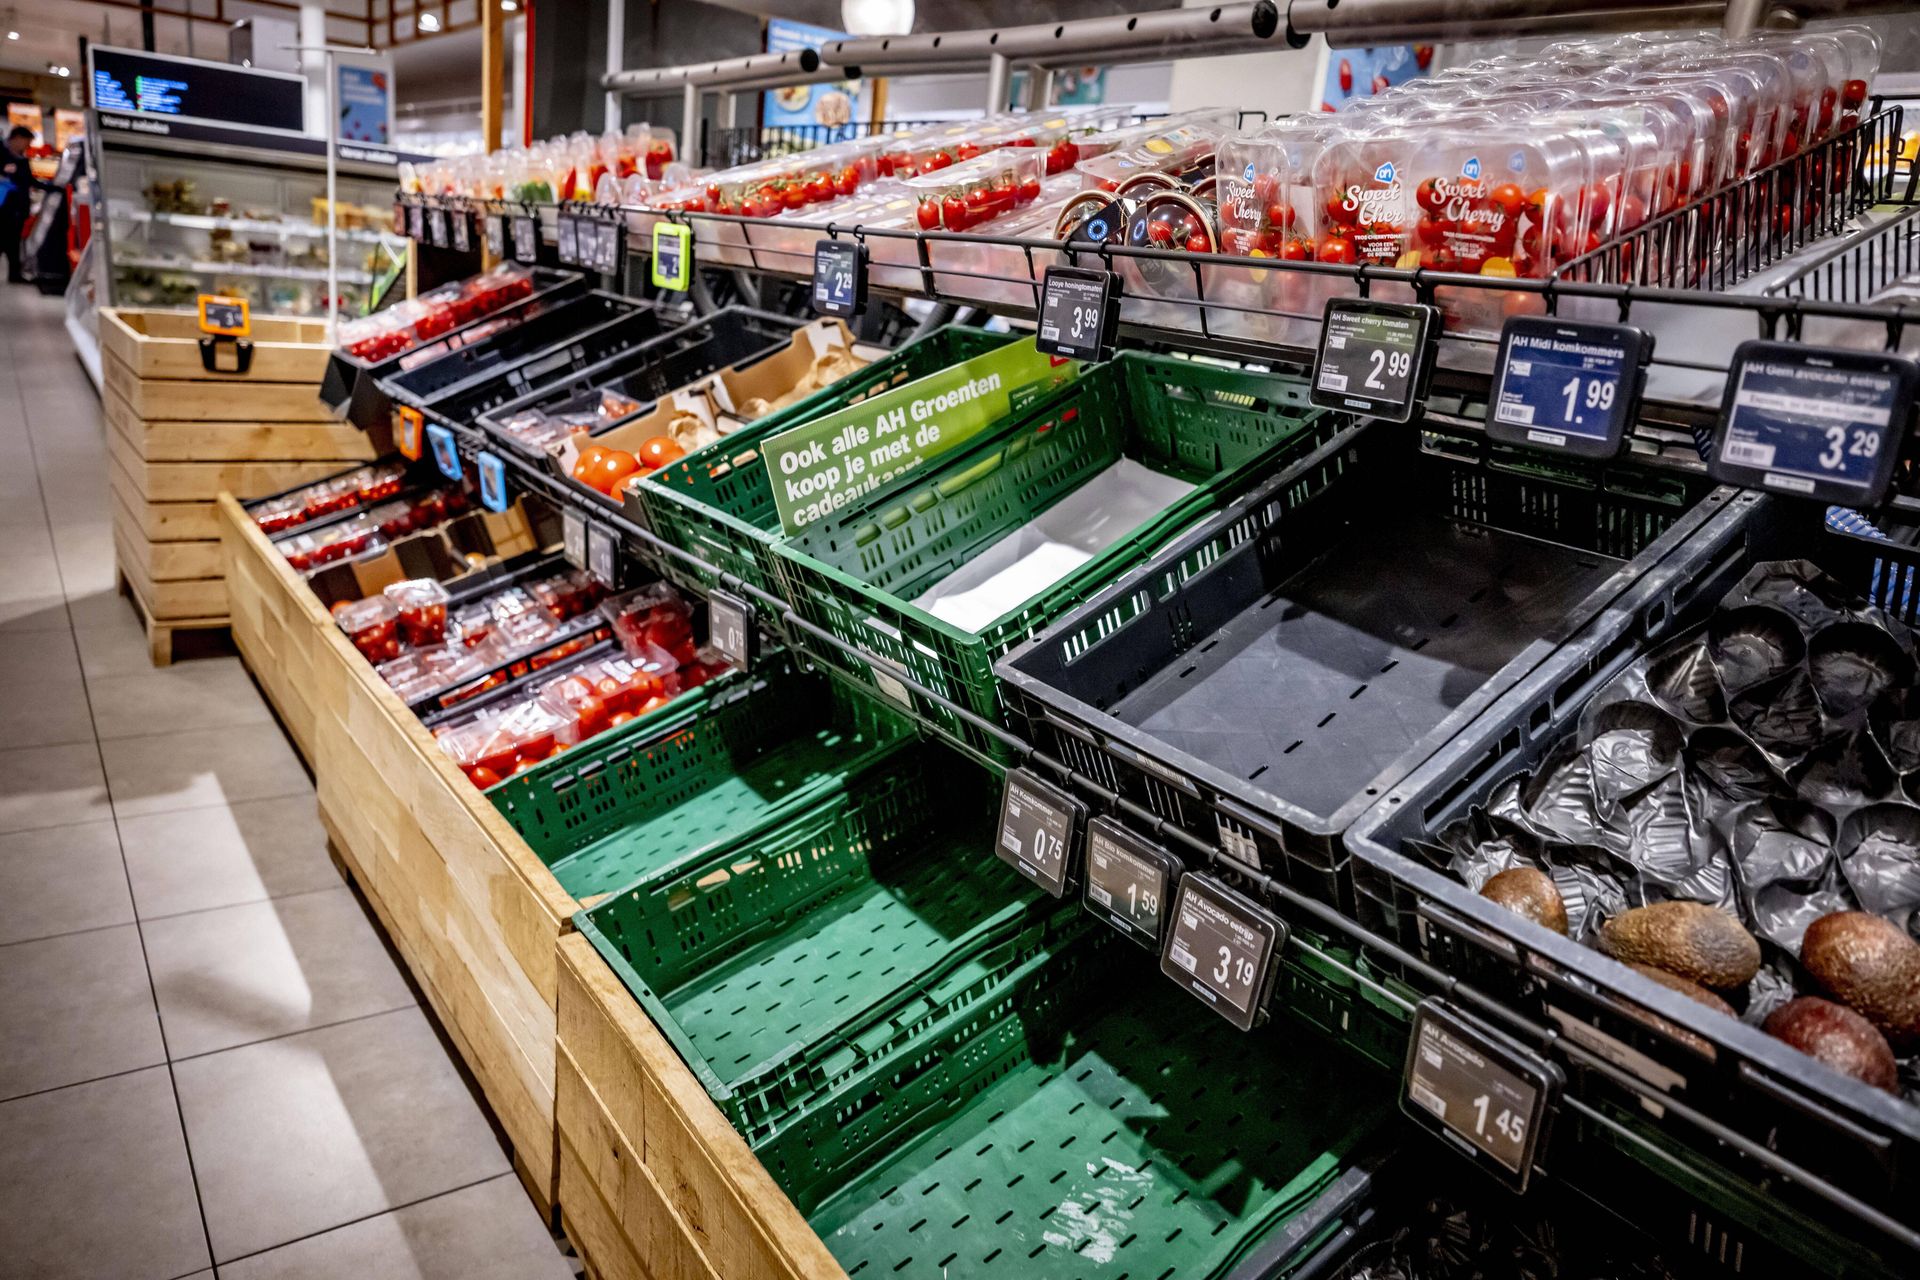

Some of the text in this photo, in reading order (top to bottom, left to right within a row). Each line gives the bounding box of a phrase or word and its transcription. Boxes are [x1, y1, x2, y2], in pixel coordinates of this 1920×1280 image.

[1226, 181, 1256, 204] Sweet
[1342, 183, 1401, 211] Sweet
[1430, 177, 1486, 205] Sweet
[1233, 198, 1262, 228] Cherry
[1359, 201, 1405, 226] Cher
[1446, 196, 1506, 232] Cherry
[1048, 280, 1064, 288] Looye
[1064, 282, 1103, 293] honingtomaten
[1071, 306, 1098, 339] 3.99
[1331, 313, 1409, 329] AH Sweet cherry tomaten
[1512, 336, 1625, 359] AH Midi komkommers
[1364, 349, 1410, 390] 2.99
[1745, 363, 1764, 374] AH
[1766, 365, 1795, 378] Gem
[1795, 368, 1848, 384] avocado
[1562, 377, 1615, 424] 1.99
[780, 440, 828, 475] Ook
[831, 423, 870, 455] alle
[876, 406, 906, 439] AH
[910, 372, 1001, 423] Groenten
[785, 423, 940, 502] koop je met de
[1819, 426, 1880, 471] 3.29
[1010, 786, 1019, 795] AH
[1019, 790, 1053, 816] Komkommer
[1034, 828, 1063, 864] 0.75
[1094, 835, 1103, 846] AH
[1105, 840, 1115, 853] Bio
[1116, 847, 1155, 877] komkommer
[1127, 883, 1158, 920] 1.59
[1186, 891, 1197, 904] AH
[1198, 897, 1229, 925] Avocado
[1230, 919, 1254, 940] eetrijp
[1213, 945, 1254, 989] 3.19
[1424, 1024, 1439, 1039] AH
[1440, 1032, 1485, 1068] Avocado
[1473, 1094, 1525, 1143] 1.45
